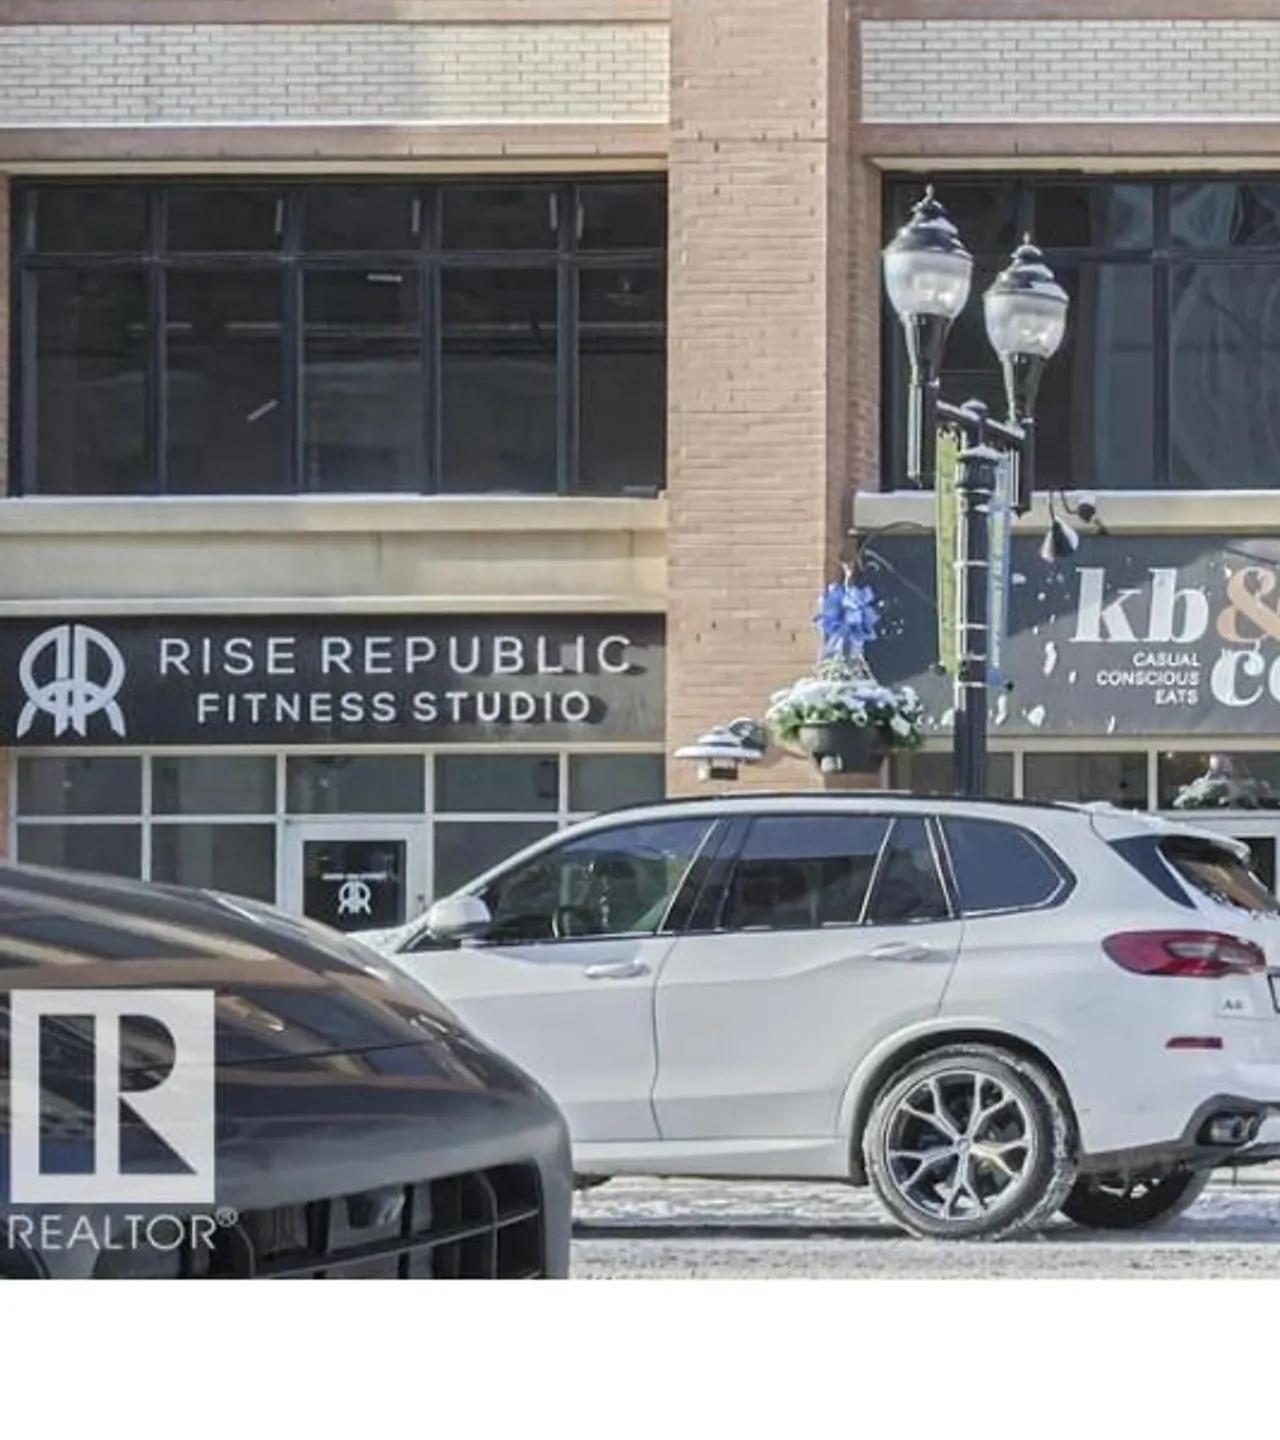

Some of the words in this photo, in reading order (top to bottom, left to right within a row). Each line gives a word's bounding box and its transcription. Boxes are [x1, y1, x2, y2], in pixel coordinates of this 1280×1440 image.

[159, 636, 297, 676] RISE
[321, 635, 632, 675] REPUBLIC
[1133, 652, 1202, 666] CASUAL
[1097, 671, 1200, 686] CONSCIOUS
[1155, 689, 1199, 705] EATS
[197, 692, 397, 724] FITNESS
[413, 690, 590, 723] STUDIO
